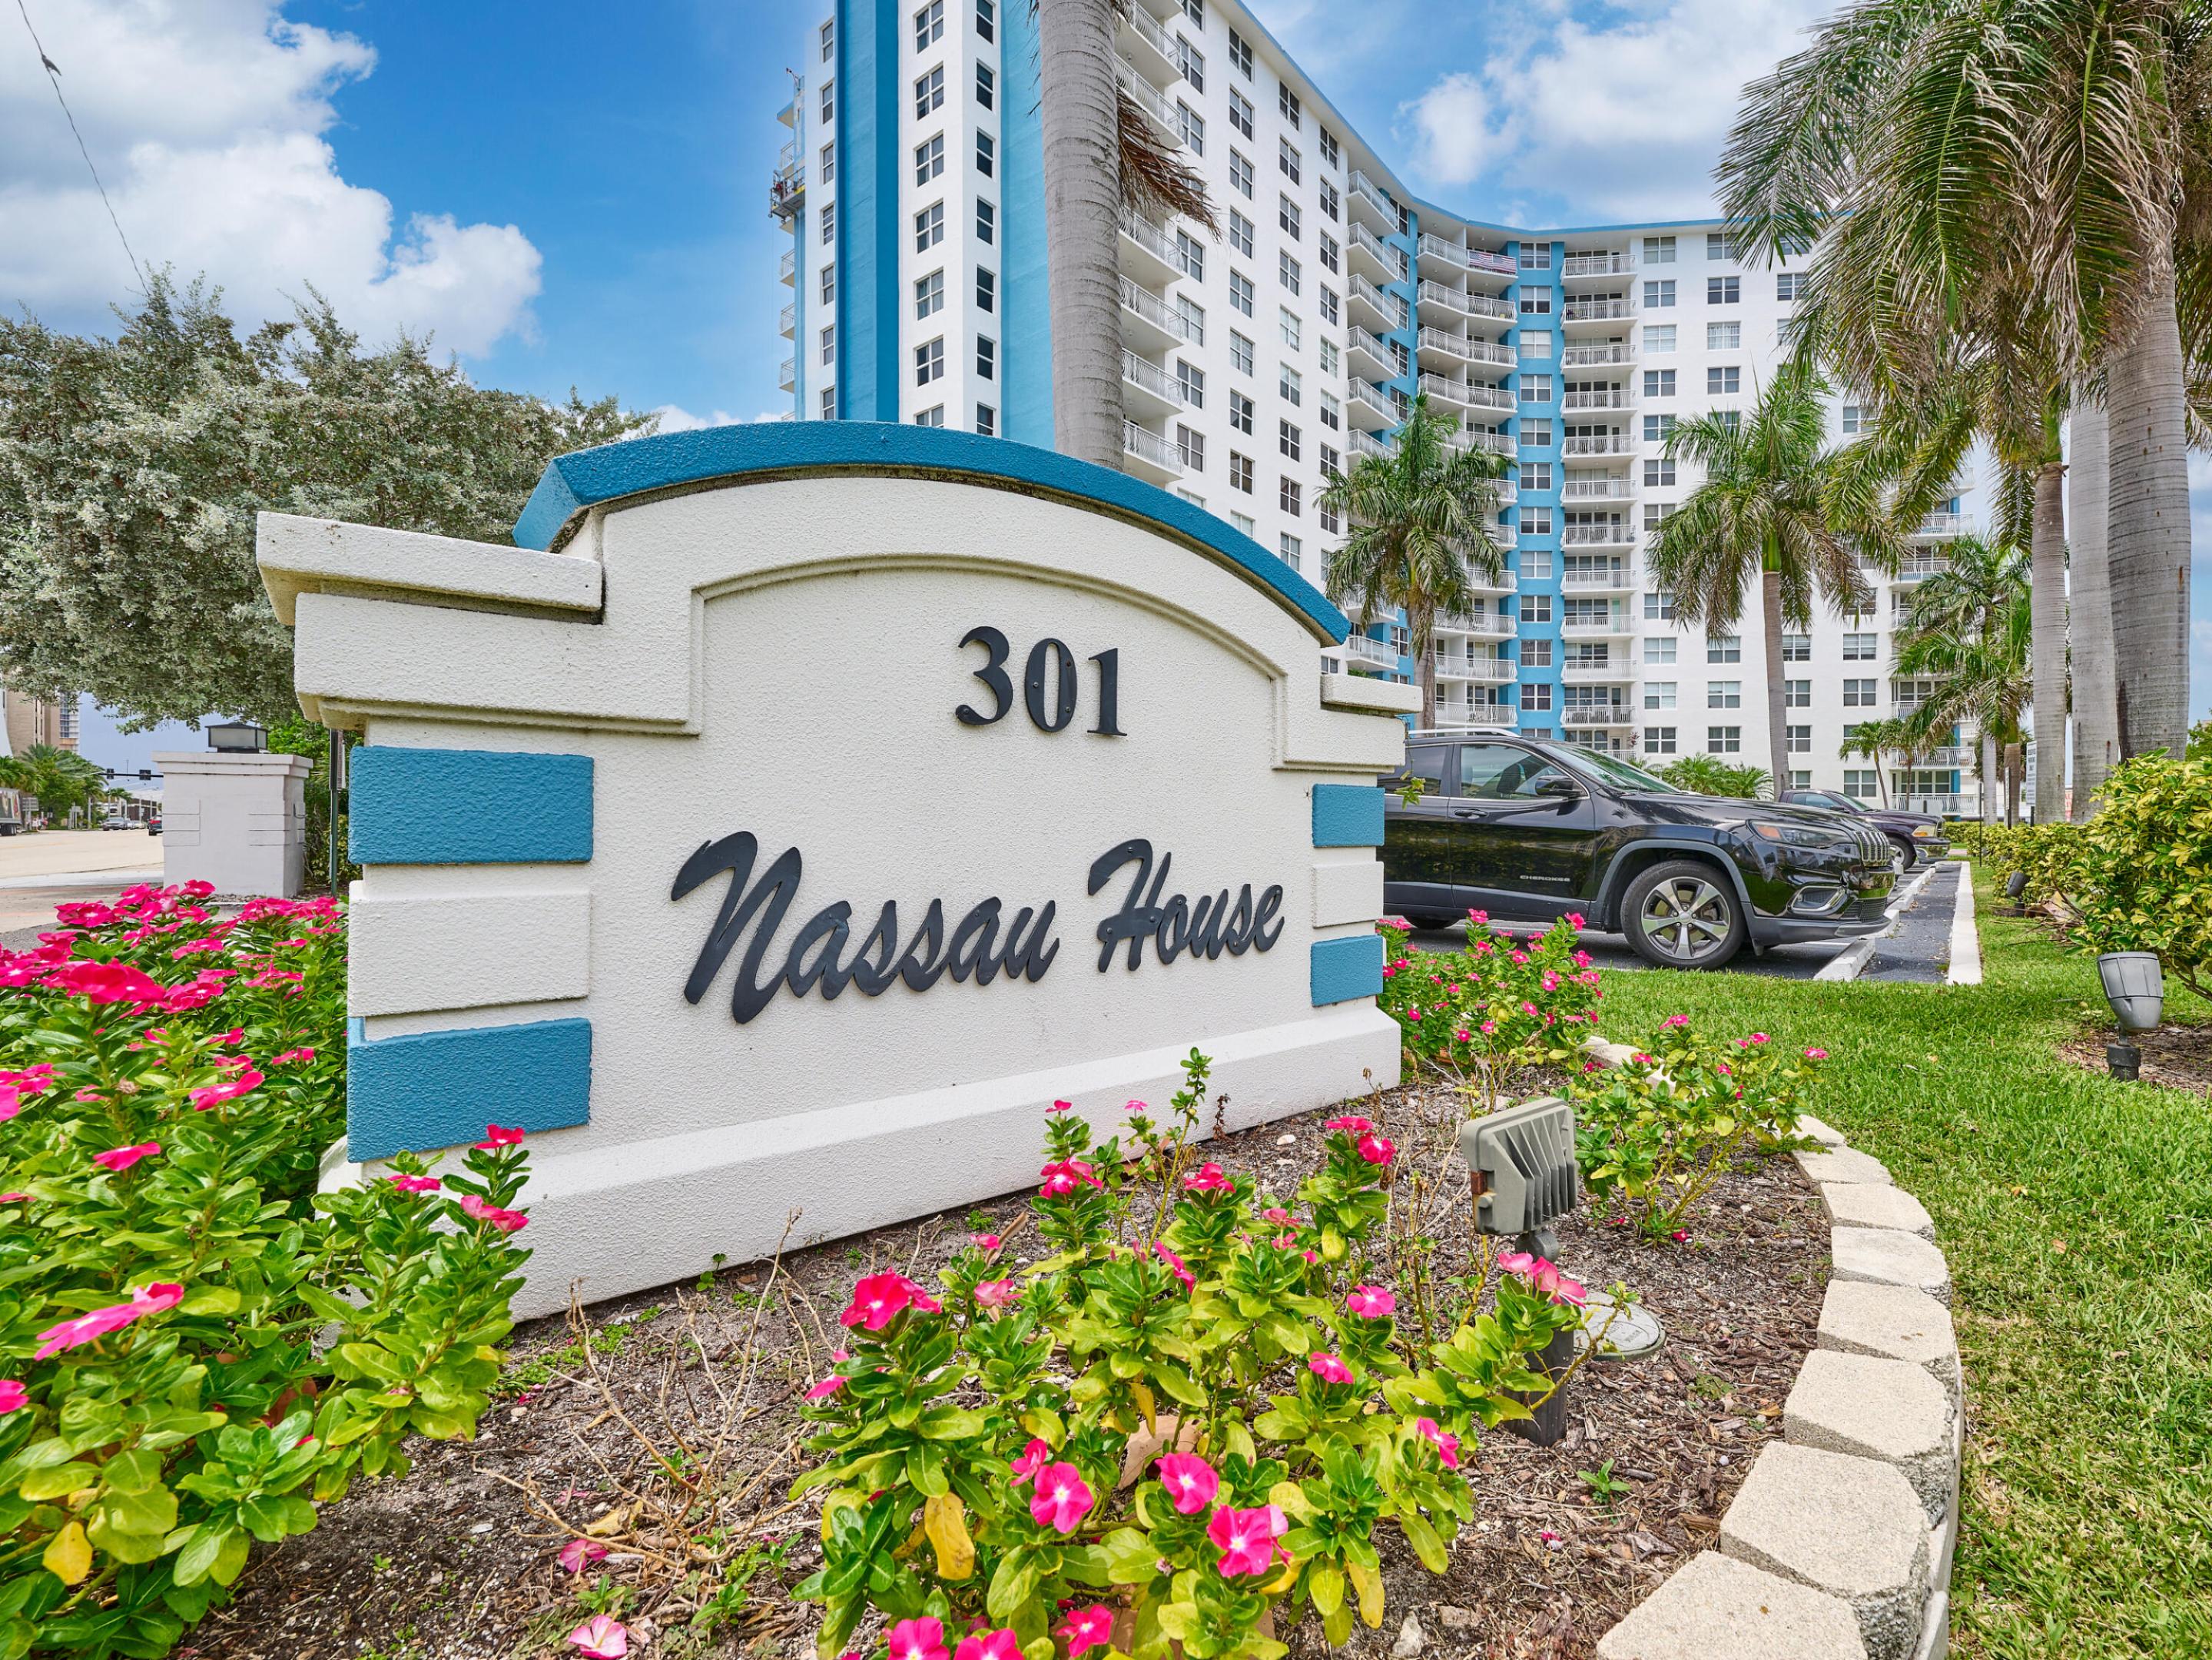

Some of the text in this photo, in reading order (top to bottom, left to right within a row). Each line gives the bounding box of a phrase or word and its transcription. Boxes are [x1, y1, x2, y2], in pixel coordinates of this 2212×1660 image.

[955, 626, 1127, 737] 301
[671, 831, 1285, 1024] Nassau House
